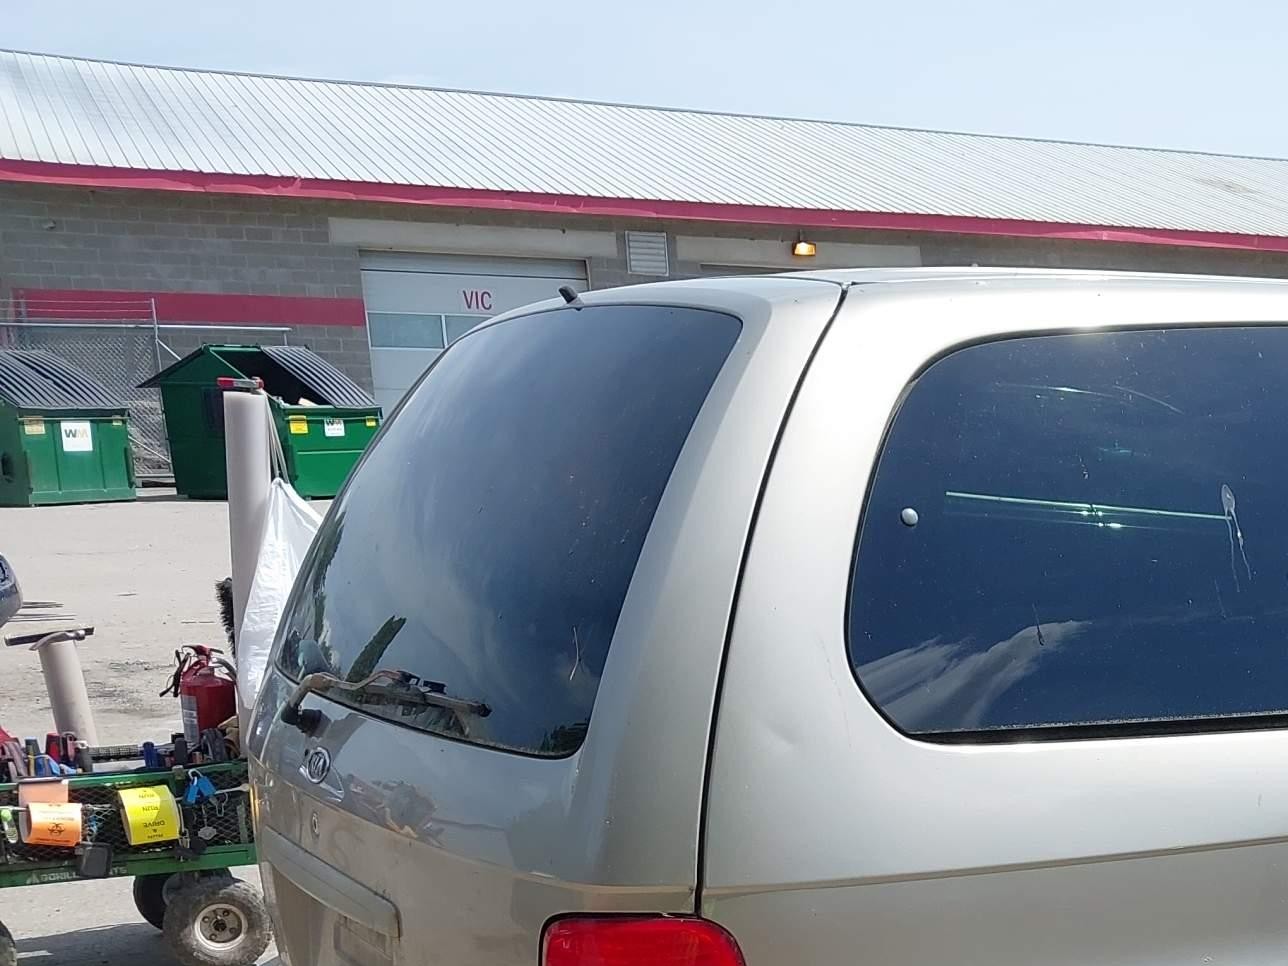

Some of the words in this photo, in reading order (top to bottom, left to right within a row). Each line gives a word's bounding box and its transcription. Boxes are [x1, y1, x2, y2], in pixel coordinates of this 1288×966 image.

[462, 290, 492, 310] VIC
[64, 428, 88, 438] WM
[143, 820, 166, 828] DRIVE
